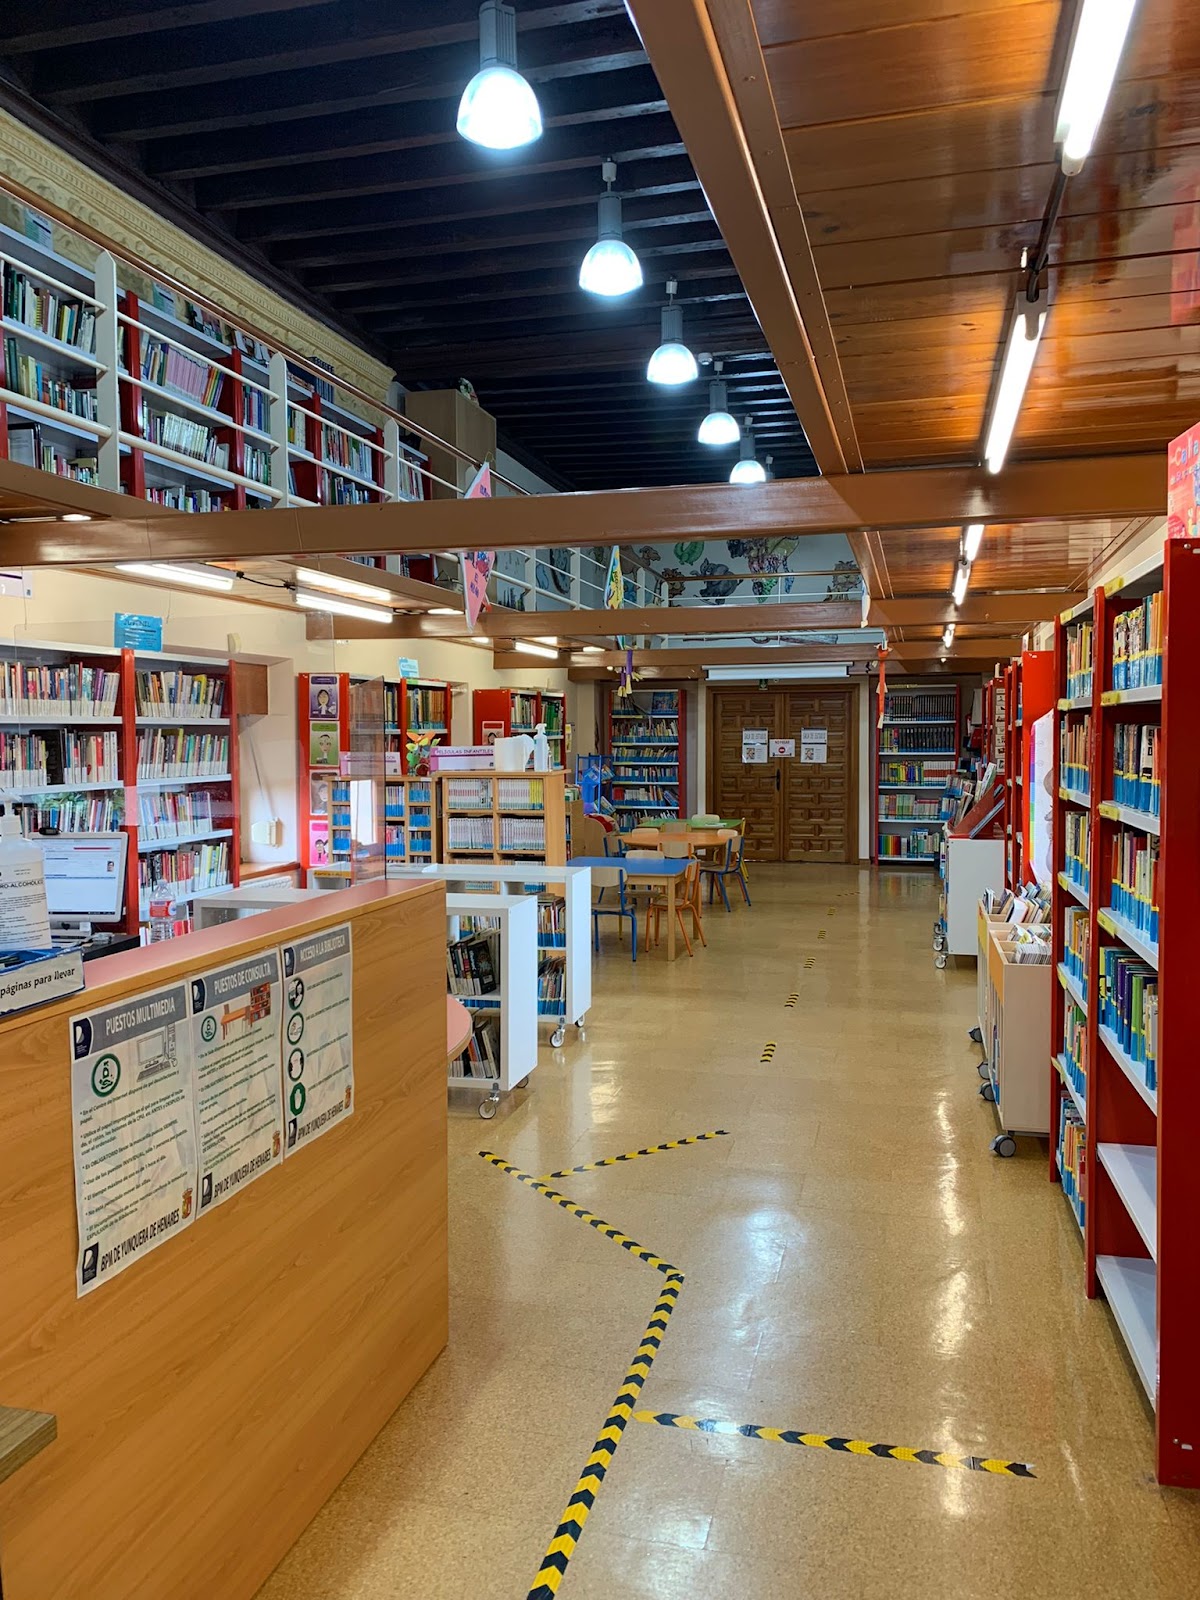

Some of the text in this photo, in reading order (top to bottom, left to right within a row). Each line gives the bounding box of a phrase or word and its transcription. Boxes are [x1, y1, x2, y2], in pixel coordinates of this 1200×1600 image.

[300, 945, 315, 963] ACCESO
[318, 941, 324, 956] LA
[324, 934, 345, 954] BIBLIOTECA
[0, 966, 76, 998] páginas para llevar
[214, 961, 271, 996] PUESTOS DE CONSULTA
[105, 996, 176, 1037] PUESTOS MULTIMEDIA
[229, 1162, 250, 1188] YUNQUERA
[249, 1158, 255, 1174] DE
[255, 1148, 271, 1170] HENARES
[100, 1206, 180, 1273] BPM DE YUNQUERA DE HENARES
